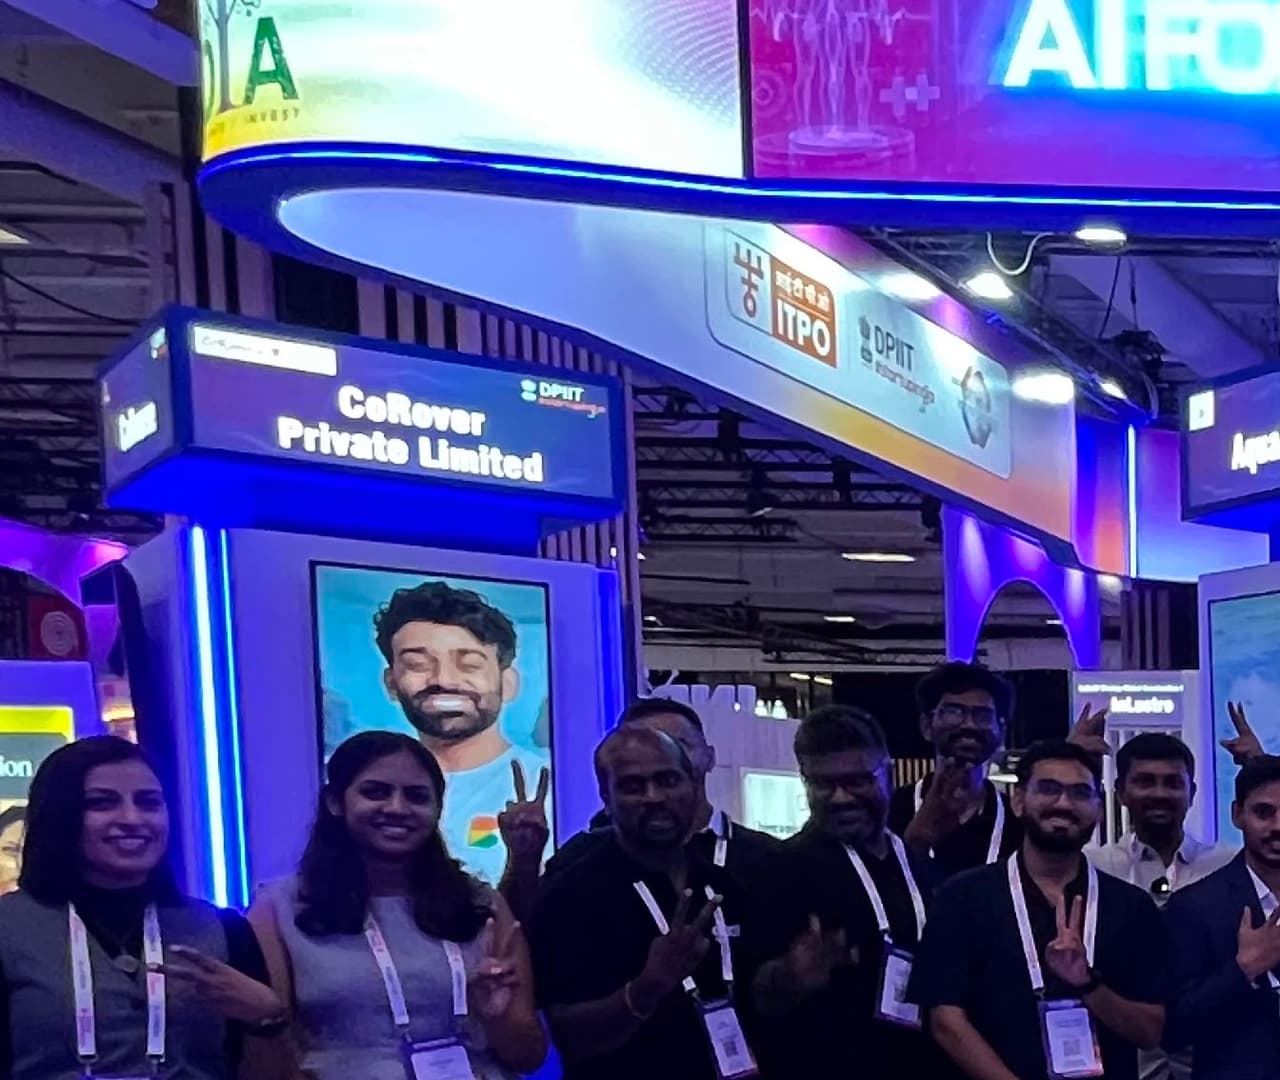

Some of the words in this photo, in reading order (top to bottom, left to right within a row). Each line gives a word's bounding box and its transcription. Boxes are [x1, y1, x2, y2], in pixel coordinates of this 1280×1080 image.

[1003, 0, 1126, 90] AI
[776, 298, 831, 357] ITPO
[874, 325, 915, 372] DPIIT
[338, 384, 486, 437] CoRover
[277, 415, 410, 465] Private
[418, 436, 544, 483] Limited
